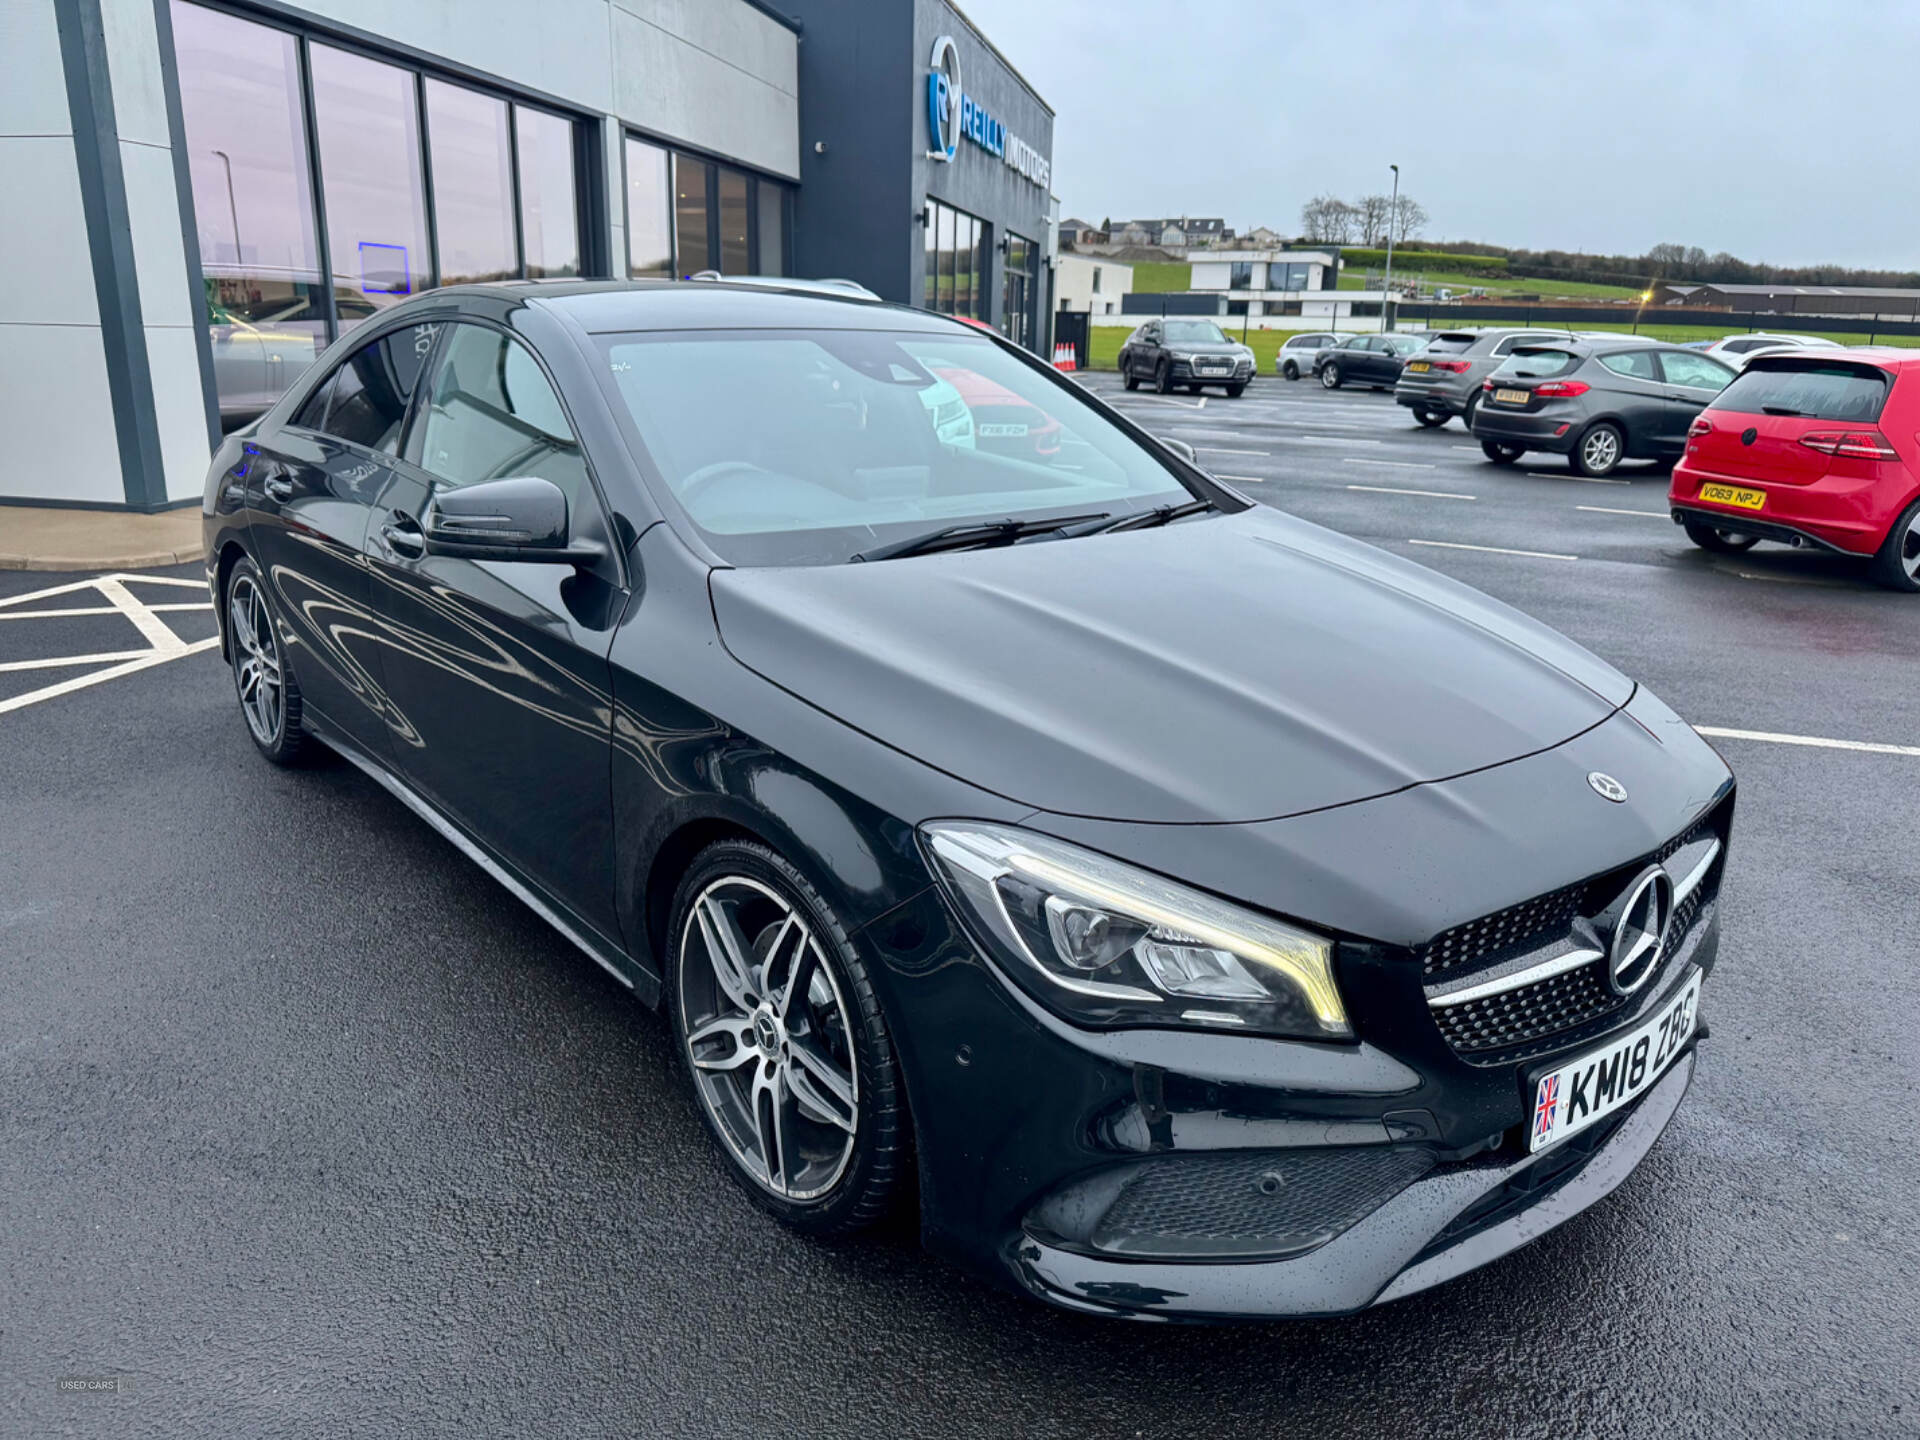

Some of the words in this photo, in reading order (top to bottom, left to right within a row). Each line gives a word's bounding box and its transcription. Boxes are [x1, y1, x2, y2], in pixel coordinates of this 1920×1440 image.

[961, 93, 1007, 160] REILLY
[1005, 132, 1049, 189] MOTORS
[1735, 491, 1762, 506] NPJ
[1565, 1034, 1651, 1127] KM18
